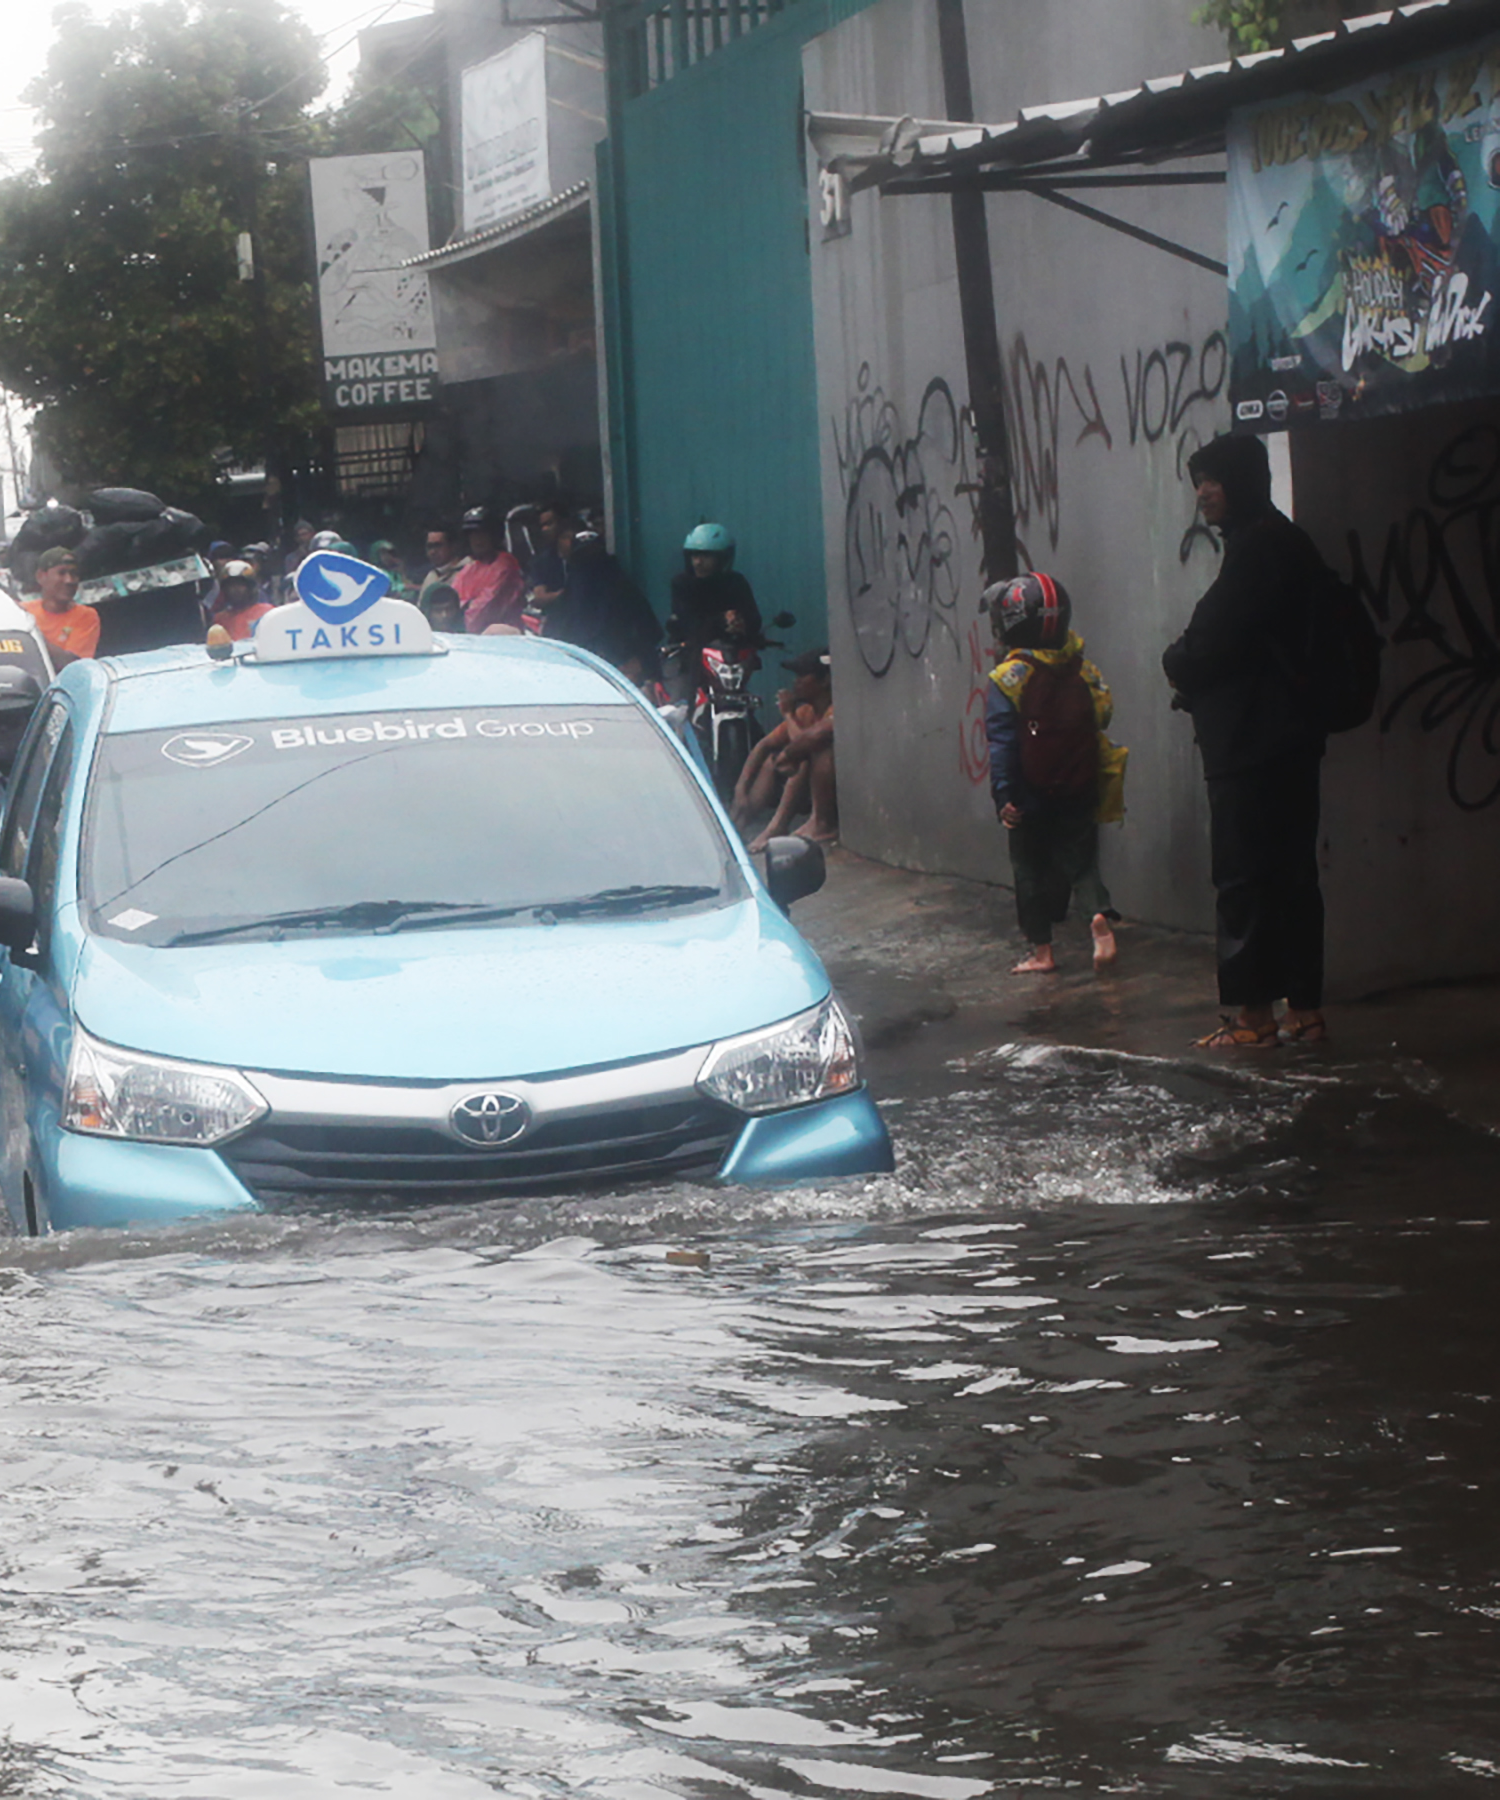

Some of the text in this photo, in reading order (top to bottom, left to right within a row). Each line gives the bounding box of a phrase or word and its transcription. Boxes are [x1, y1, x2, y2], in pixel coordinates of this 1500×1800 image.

[324, 352, 439, 382] MAKEMA
[335, 378, 432, 407] COFFEE
[285, 622, 403, 651] TAKSI
[273, 717, 595, 750] Bluebird Group
